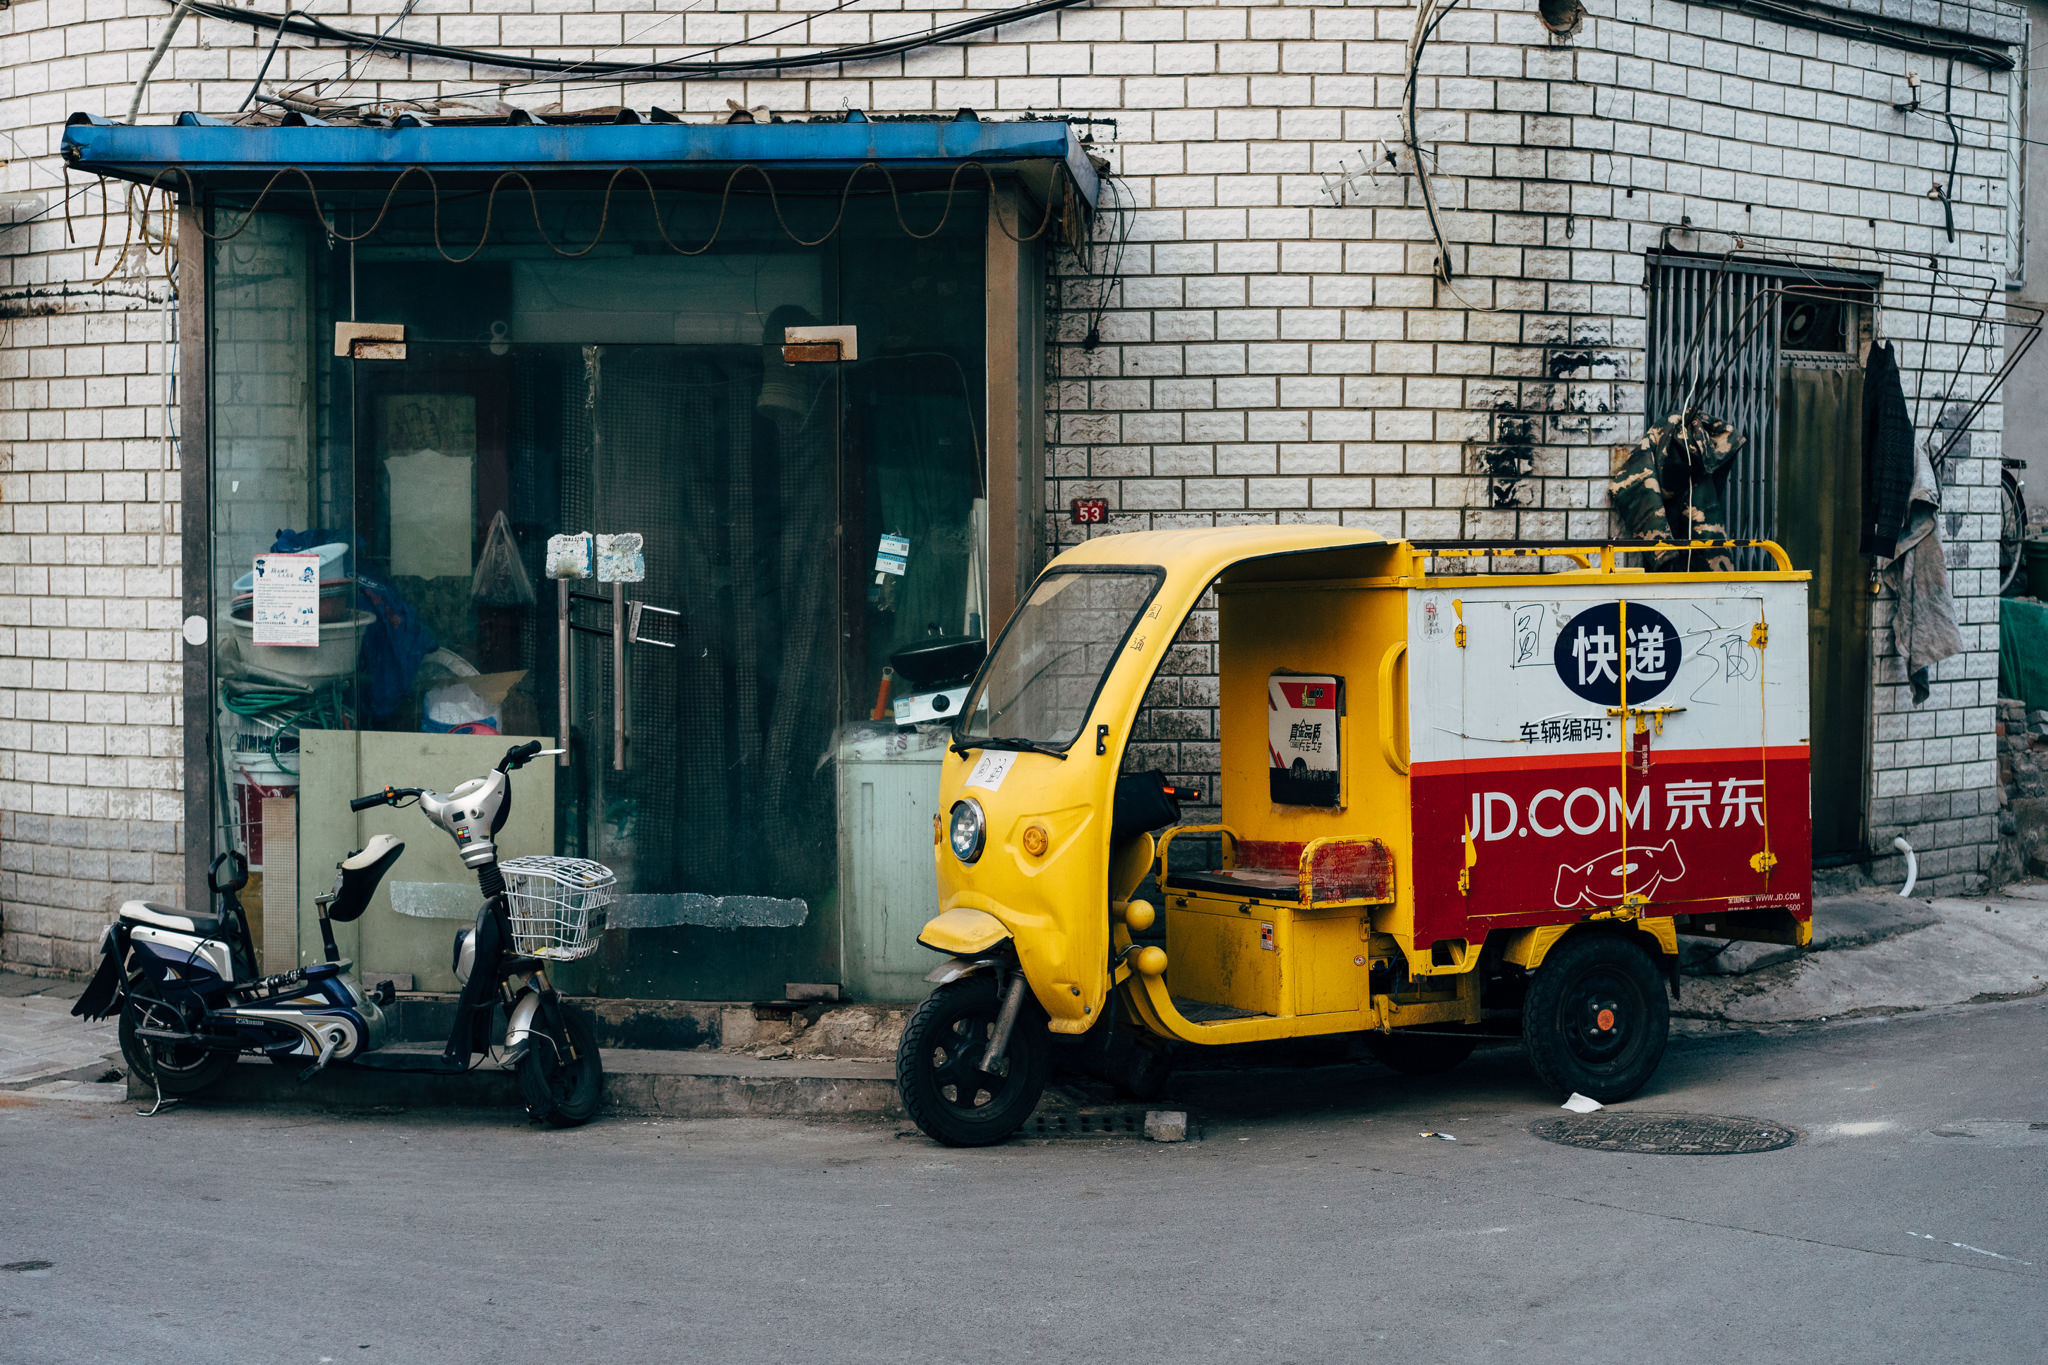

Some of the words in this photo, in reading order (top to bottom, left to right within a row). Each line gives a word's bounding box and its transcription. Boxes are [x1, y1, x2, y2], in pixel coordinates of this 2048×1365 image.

[1080, 507, 1100, 521] 53
[1572, 624, 1667, 685] 快递
[1461, 785, 1650, 842] JD.COM
[1665, 777, 1765, 831] 京东
